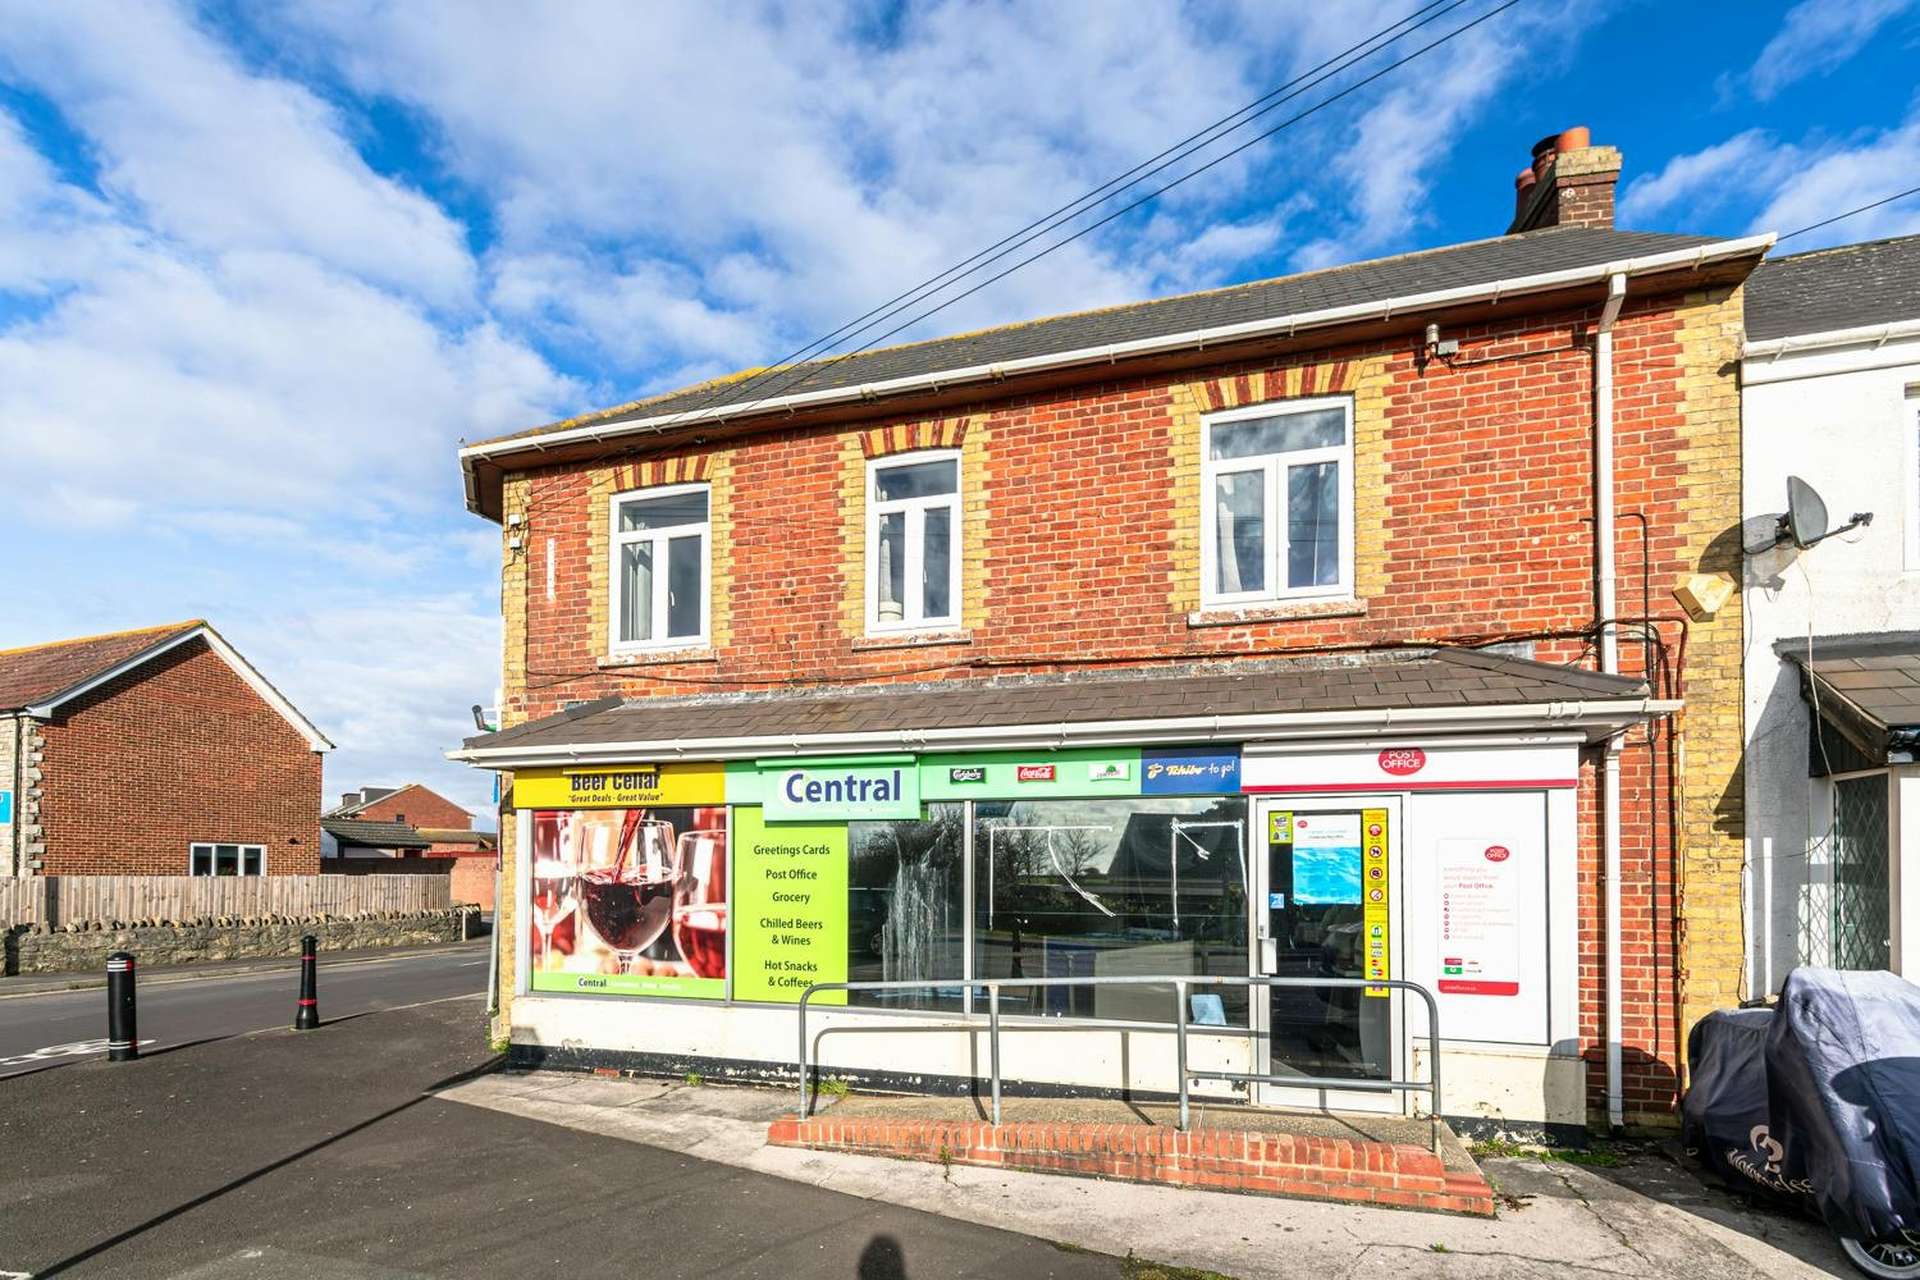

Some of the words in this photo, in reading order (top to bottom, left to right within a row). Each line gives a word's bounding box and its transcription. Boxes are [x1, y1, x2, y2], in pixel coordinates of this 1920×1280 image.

[1388, 750, 1414, 760] POST
[1382, 758, 1420, 768] OFFICE
[1166, 764, 1206, 776] Tchibo
[1208, 762, 1219, 775] to
[1220, 760, 1235, 779] go!
[572, 773, 607, 791] Beer
[612, 772, 660, 790] Cellar
[786, 770, 901, 803] Central
[592, 794, 612, 802] Deals
[616, 793, 637, 802] Great
[753, 844, 801, 856] Greetings
[802, 844, 831, 855] Cards
[766, 870, 788, 880] Post
[789, 869, 818, 880] Office
[772, 892, 811, 904] Grocery
[760, 918, 794, 929] Chilled
[796, 919, 823, 930] Beers
[772, 935, 780, 944] &
[781, 935, 811, 946] Wines
[764, 960, 782, 971] Hot
[784, 960, 818, 972] Snacks
[579, 978, 607, 988] Central
[768, 976, 776, 986] &
[778, 976, 814, 988] Coffees
